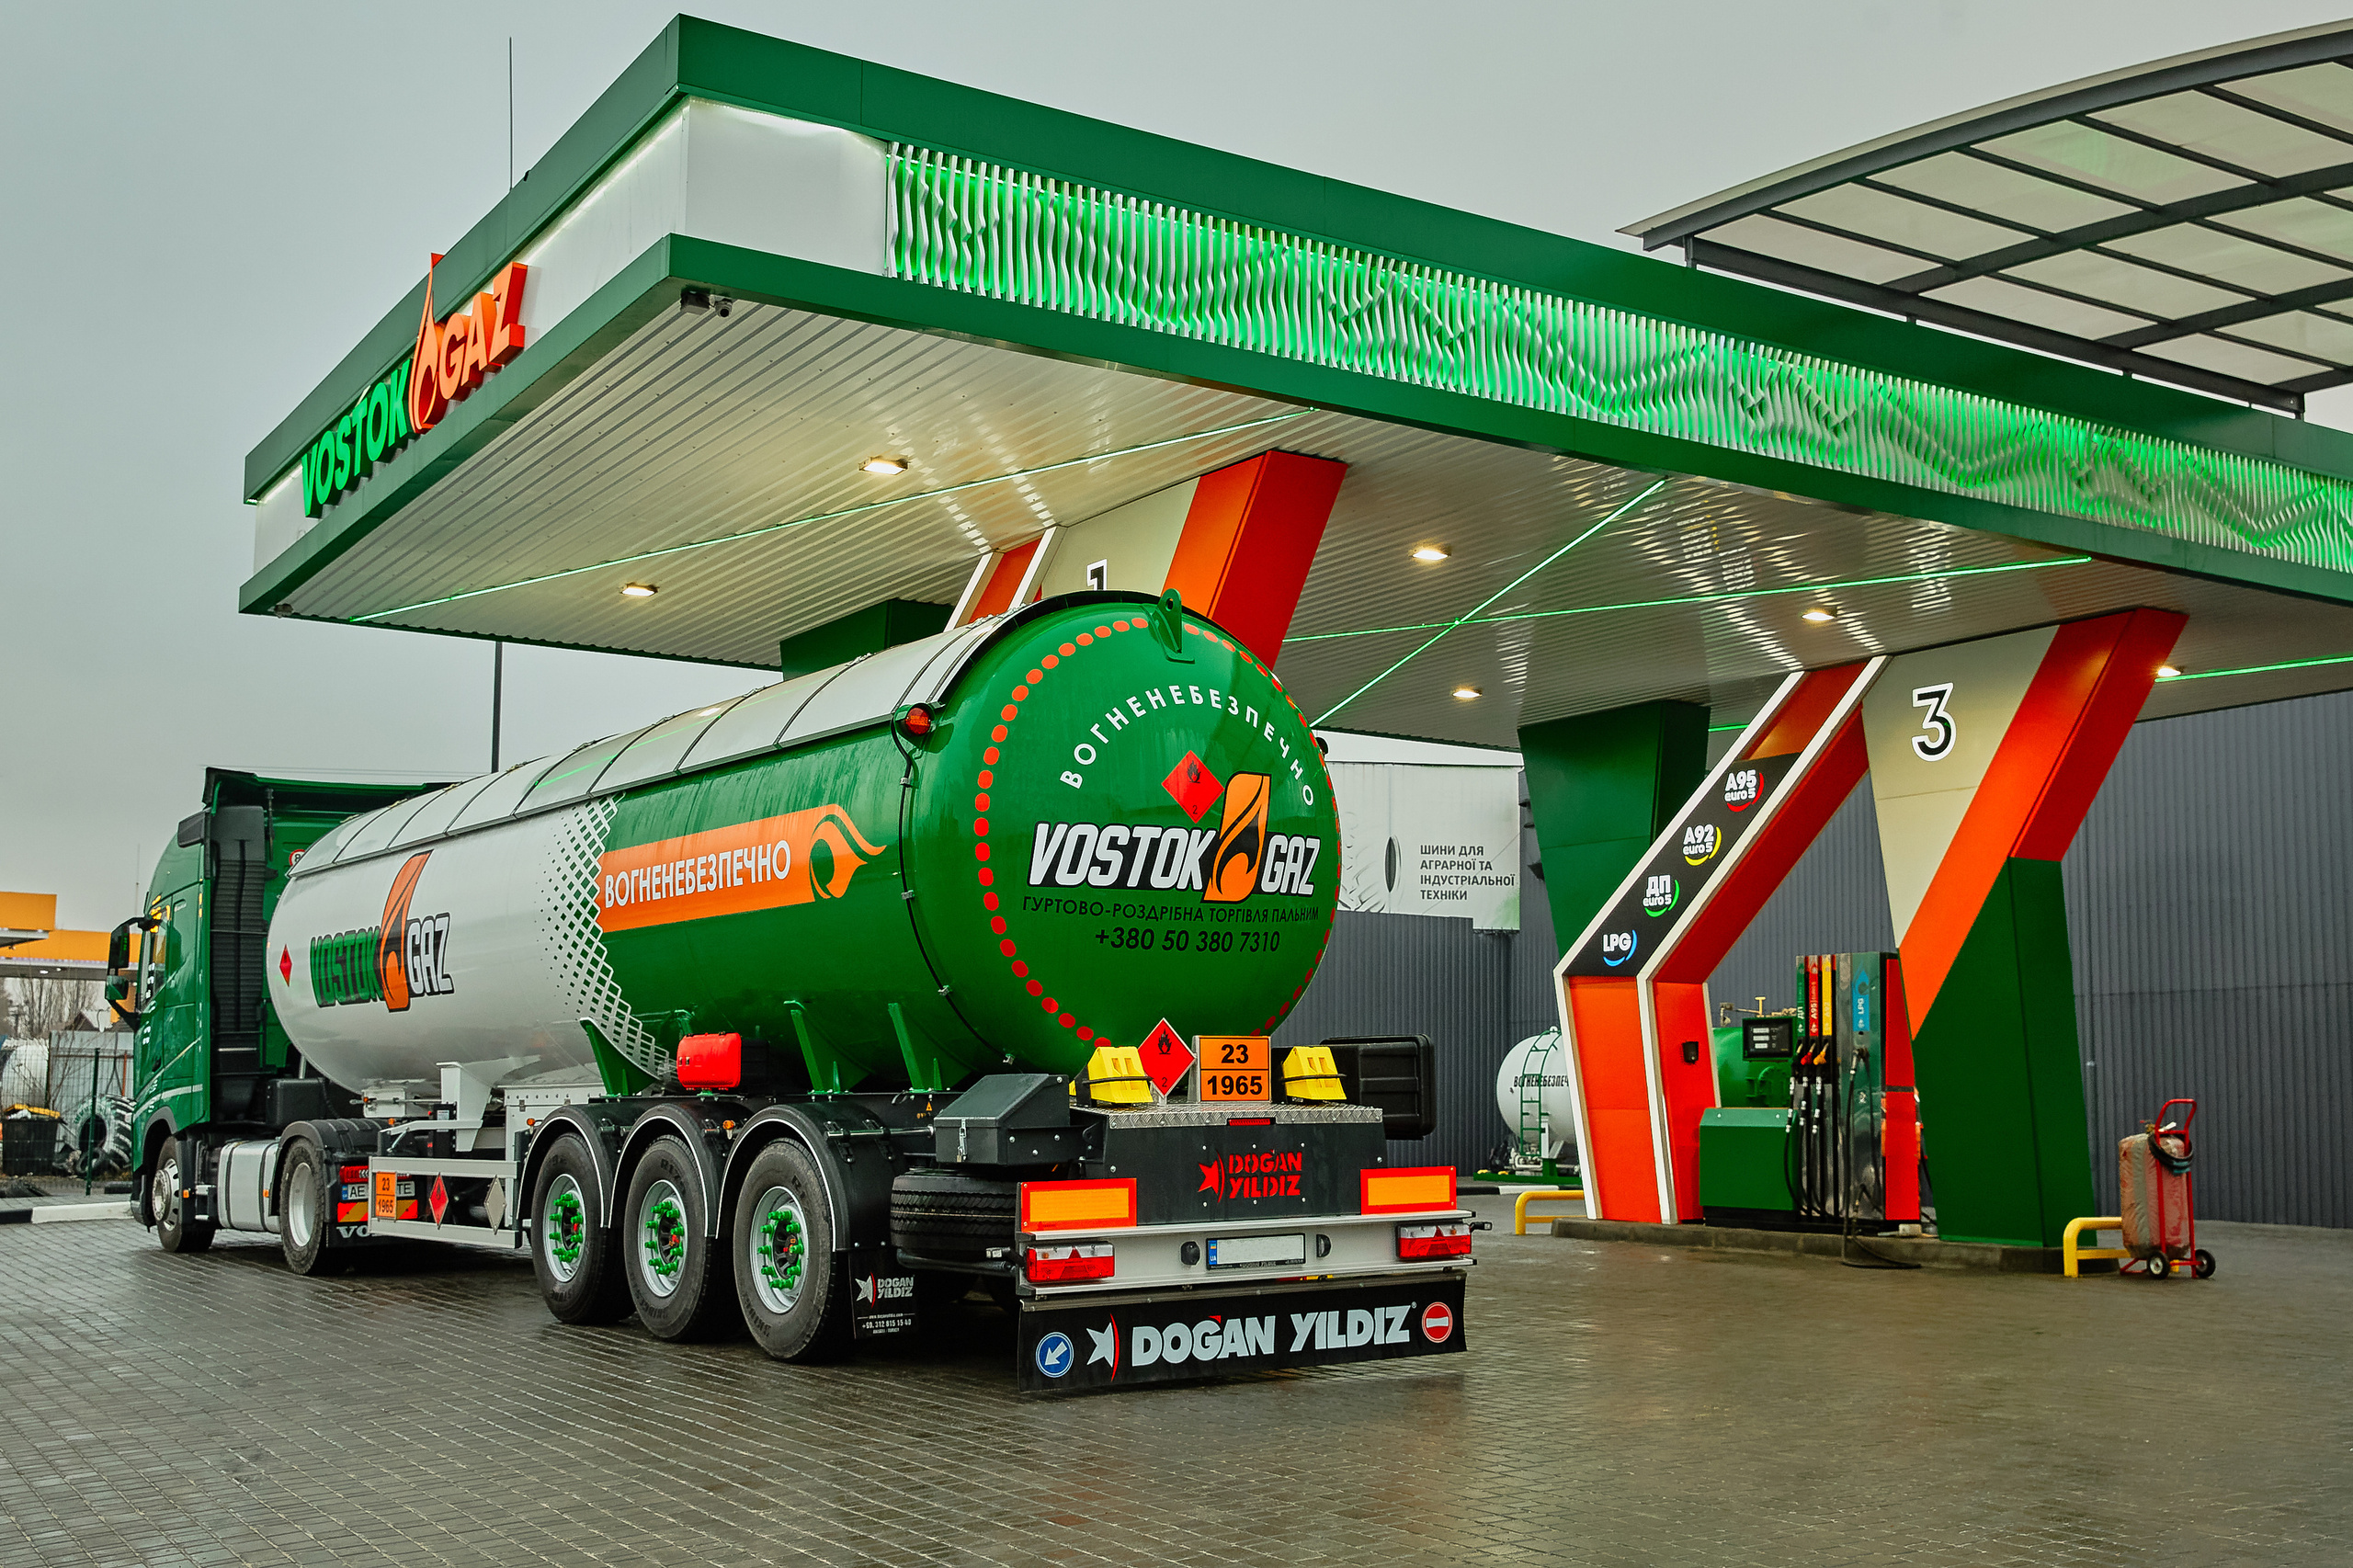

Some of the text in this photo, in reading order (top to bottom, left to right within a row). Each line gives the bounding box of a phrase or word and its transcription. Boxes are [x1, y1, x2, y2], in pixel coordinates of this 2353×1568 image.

[301, 261, 528, 518] VOSTOK GAZ
[1912, 683, 1956, 762] 3
[1059, 684, 1314, 806] ВОГНЕНЕБЕЗПЕЧНО
[1192, 804, 1199, 815] 2
[1028, 823, 1321, 895] VOSTOK GAZ
[1420, 845, 1484, 857] ШИНИ ДЛЯ
[605, 840, 790, 908] ВОГНЕНЕБЕЗПЕЧНО
[1420, 858, 1493, 871] АГРАРНОЇ ТА
[1420, 873, 1516, 887] ІНДУСТРІАЛЬНОЇ
[1646, 875, 1671, 897] ДП
[1420, 890, 1468, 900] ТЕХНІКИ
[1023, 896, 1319, 922] ГУРТОВО-РОЗДРІБНА ТОРГІВЛЯ ПАЛЬНИМ
[1095, 926, 1280, 952] +380 50 380 7310
[1603, 933, 1631, 951] LPG
[311, 914, 453, 1006] VOSTOK GAZ
[1221, 1044, 1249, 1063] 23
[1162, 1077, 1167, 1087] 2
[1207, 1075, 1263, 1096] 1965
[1514, 1074, 1569, 1087] ВОГНЕНЕБЕЗПЕЧ
[349, 1186, 366, 1198] AE
[381, 1177, 391, 1191] 23
[1229, 1175, 1301, 1199] YILDIZ
[378, 1199, 393, 1213] 1965
[878, 1287, 913, 1299] YILDIZ
[1290, 1304, 1411, 1352] YILDIZ
